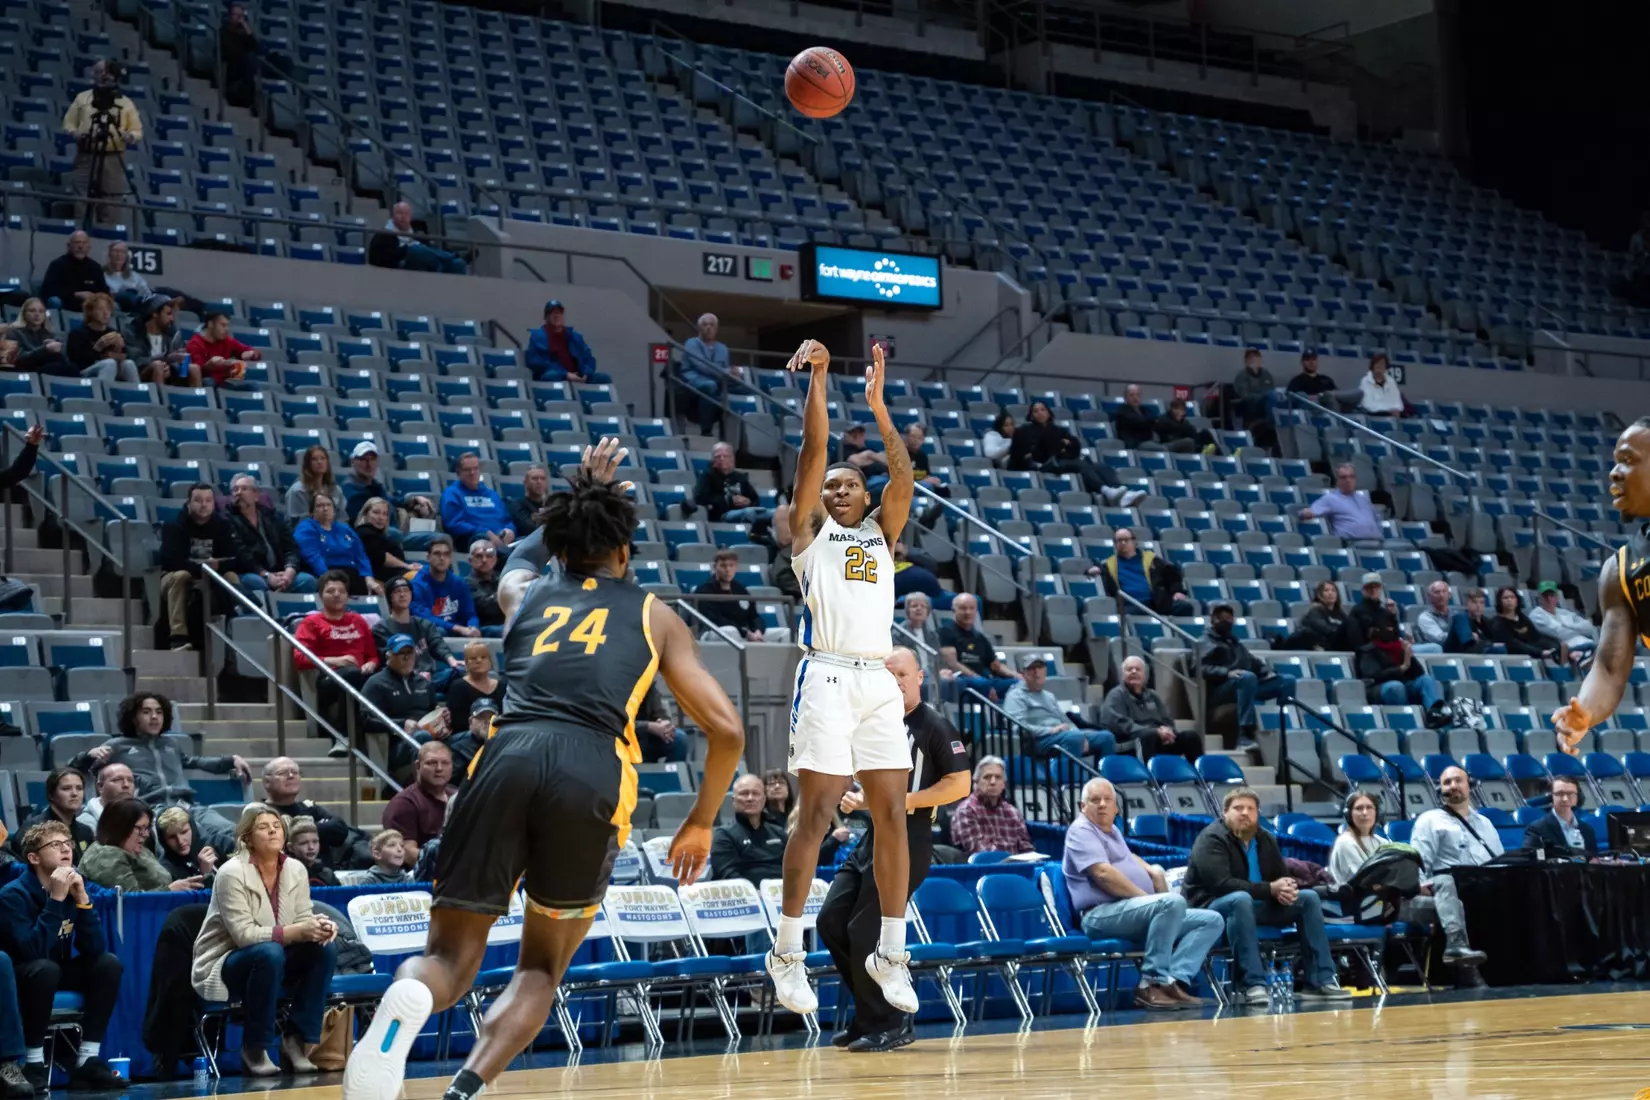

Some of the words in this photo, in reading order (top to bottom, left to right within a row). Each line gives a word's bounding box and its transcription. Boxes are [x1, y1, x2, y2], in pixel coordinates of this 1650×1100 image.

[129, 250, 156, 271] 15
[707, 255, 734, 273] 217
[819, 262, 838, 278] fort
[839, 267, 871, 282] wayne
[845, 546, 877, 584] 22
[532, 605, 610, 657] 24
[721, 898, 748, 907] WAYNE
[807, 897, 825, 905] AYNE
[373, 915, 394, 924] FORT
[397, 913, 425, 923] WAYNE
[704, 908, 751, 918] MASTODONS
[375, 923, 429, 934] MASTODONS
